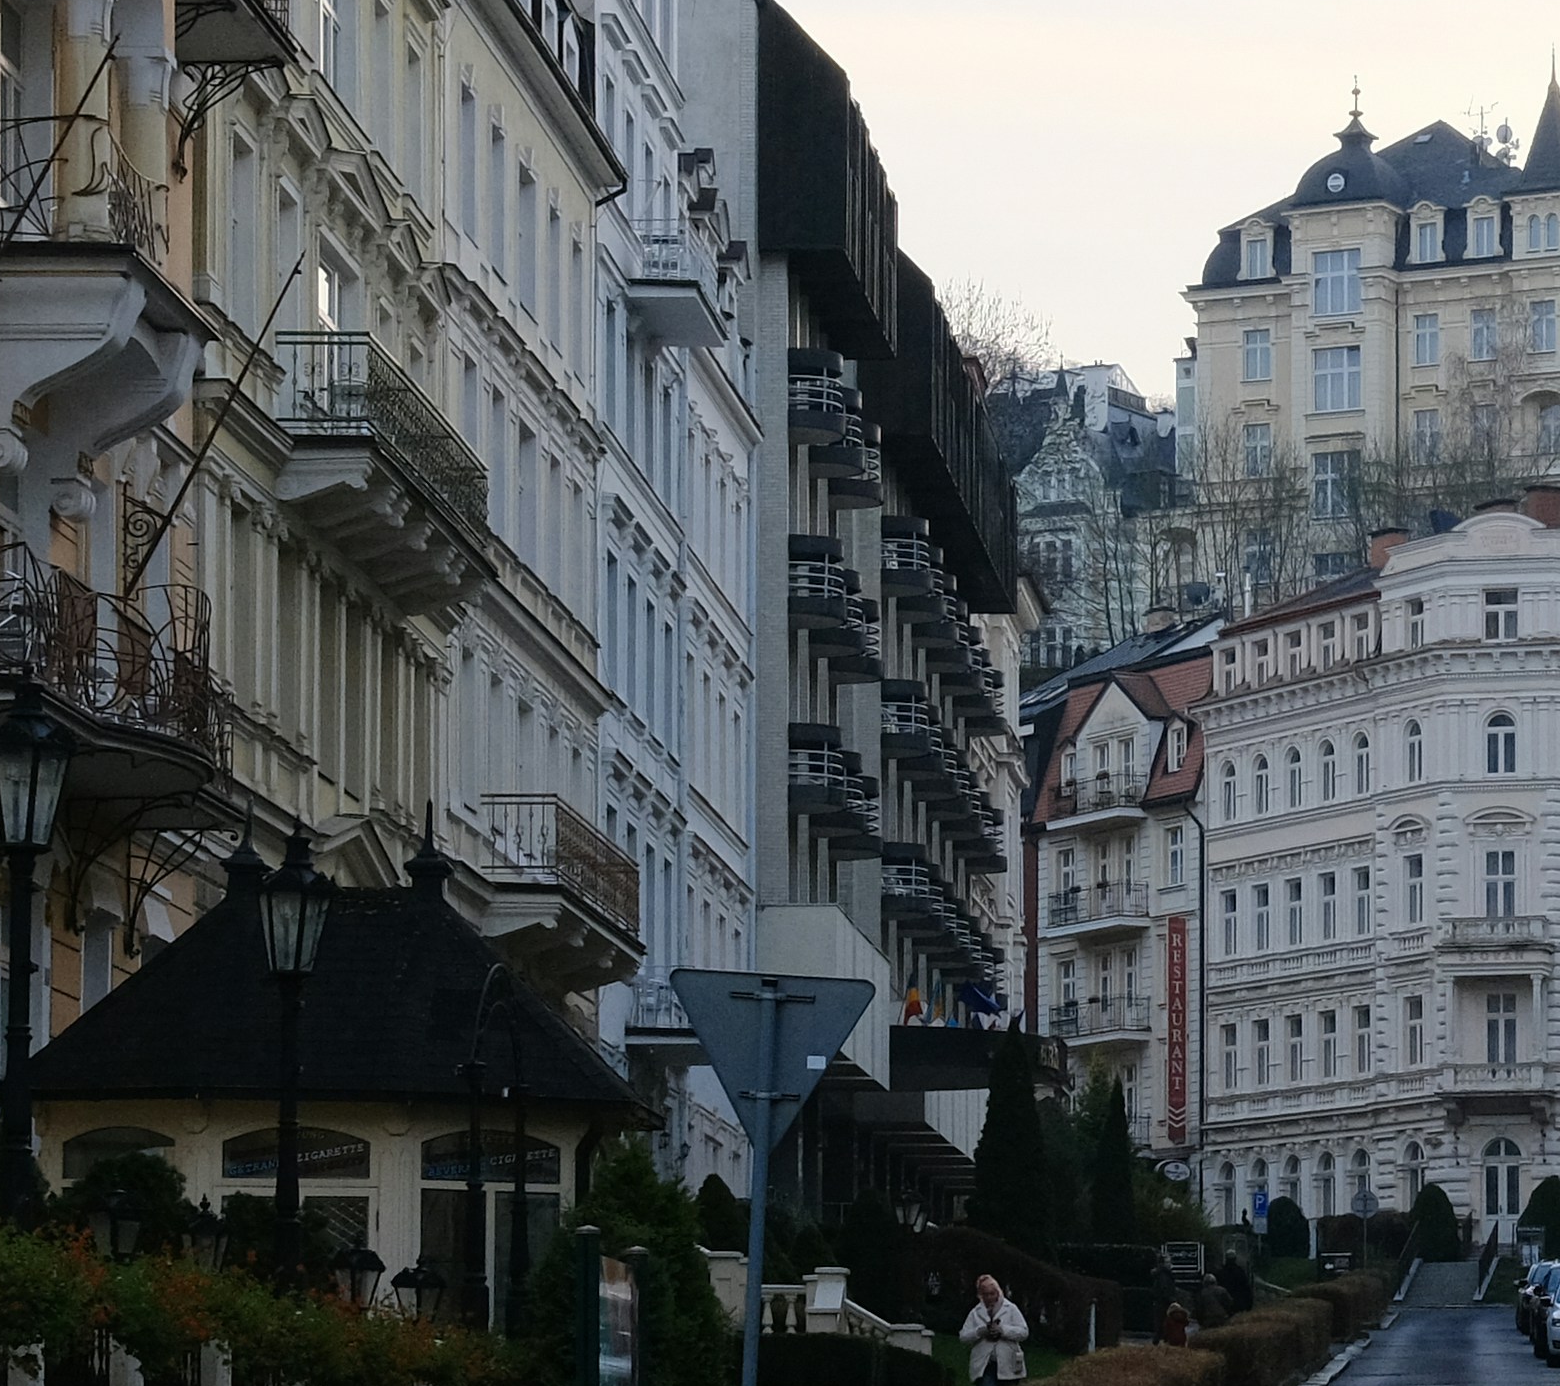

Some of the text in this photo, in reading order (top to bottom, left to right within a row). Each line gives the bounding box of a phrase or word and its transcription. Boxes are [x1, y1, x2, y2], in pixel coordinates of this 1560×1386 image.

[1171, 932, 1183, 1090] RESTAURANT
[490, 1147, 556, 1166] CIGETTE
[1255, 1194, 1265, 1210] P
